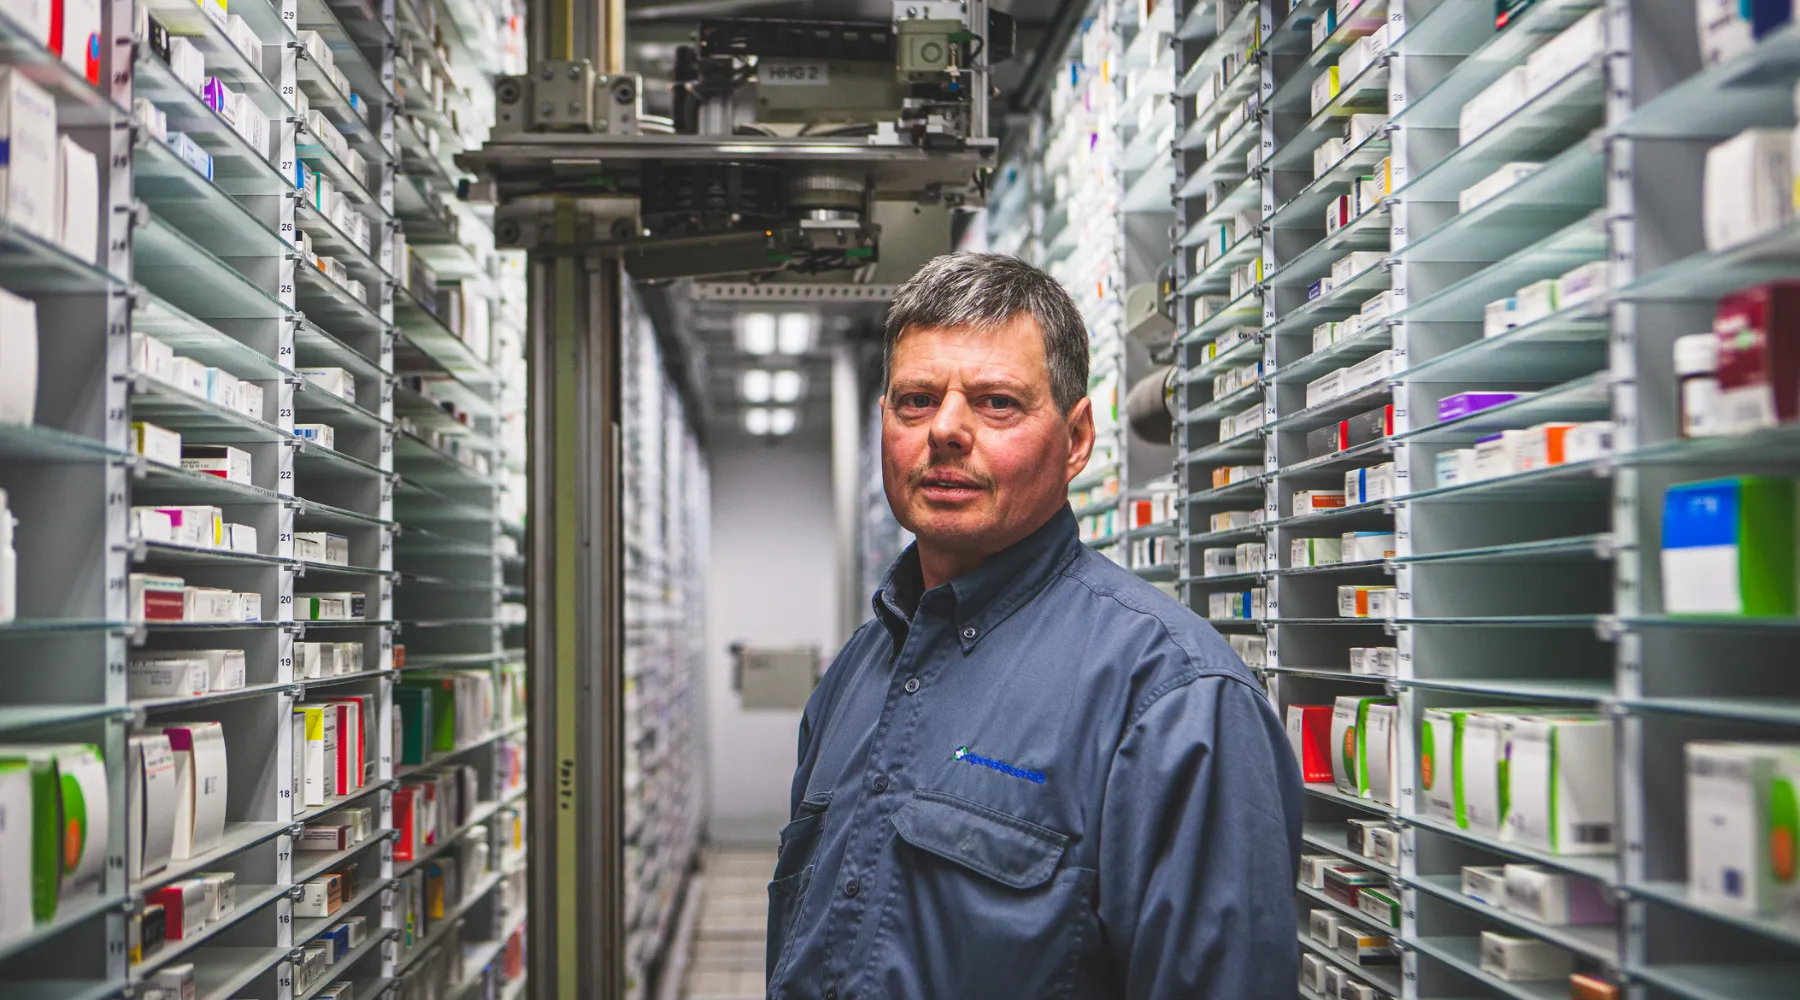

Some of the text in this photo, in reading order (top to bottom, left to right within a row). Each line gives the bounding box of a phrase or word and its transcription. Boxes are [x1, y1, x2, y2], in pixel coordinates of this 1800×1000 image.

[283, 11, 294, 20] 29
[1391, 13, 1402, 21] 29
[808, 66, 819, 80] 2
[282, 86, 294, 95] 28
[282, 161, 293, 170] 27
[282, 223, 293, 232] 26
[281, 284, 292, 293] 25
[281, 346, 292, 355] 24
[280, 408, 292, 417] 23
[280, 471, 292, 480] 22
[280, 533, 291, 542] 21
[280, 595, 292, 604] 20
[280, 658, 291, 667] 19
[279, 789, 290, 798] 18
[279, 852, 289, 861] 17
[278, 914, 290, 923] 16
[279, 977, 290, 987] 15
